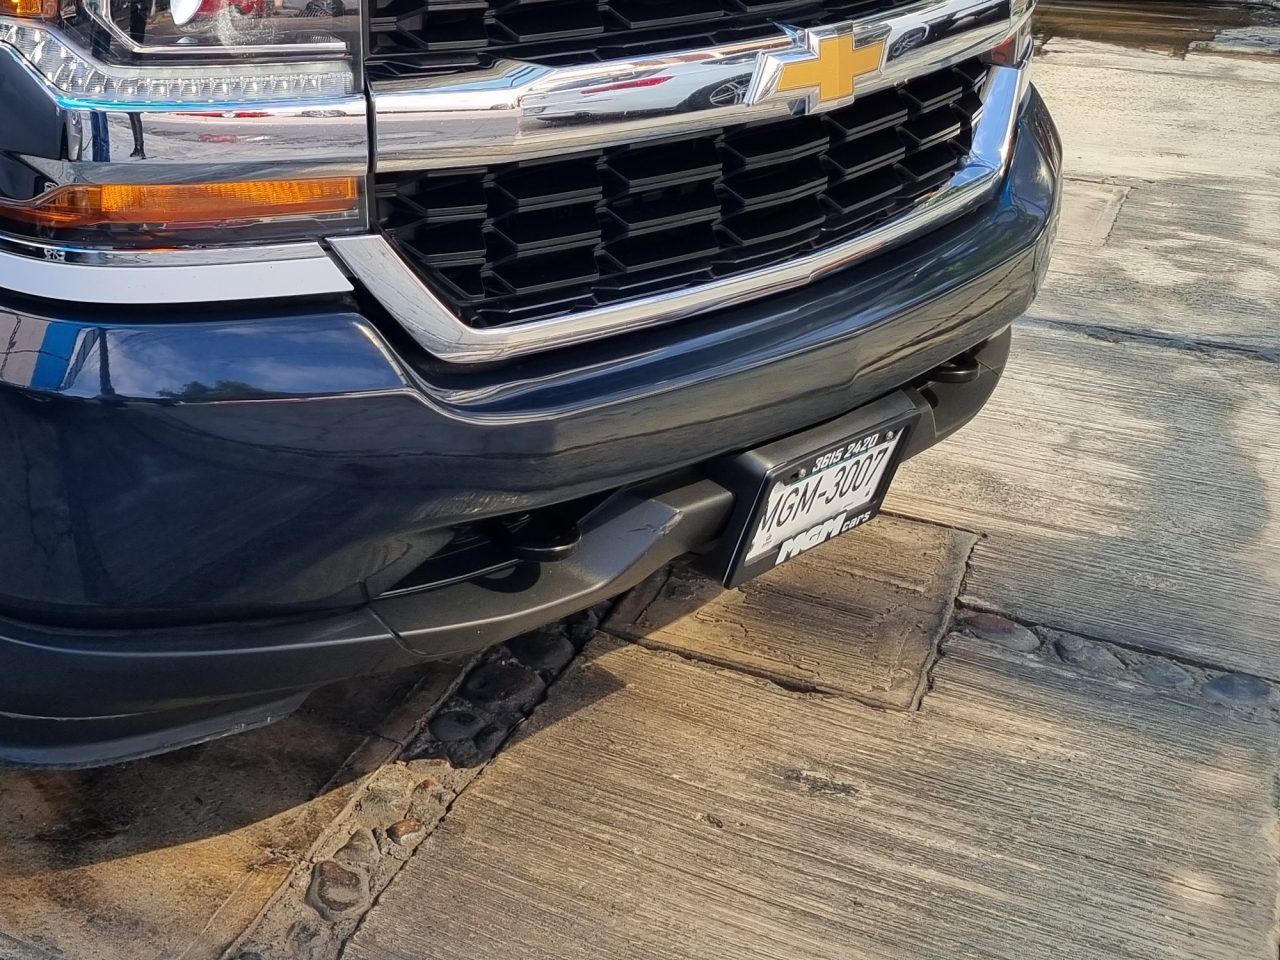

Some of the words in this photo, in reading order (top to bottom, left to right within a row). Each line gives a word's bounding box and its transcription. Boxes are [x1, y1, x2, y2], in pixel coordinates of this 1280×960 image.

[811, 447, 844, 473] 3615
[844, 434, 879, 459] 2420
[841, 511, 871, 532] cars
